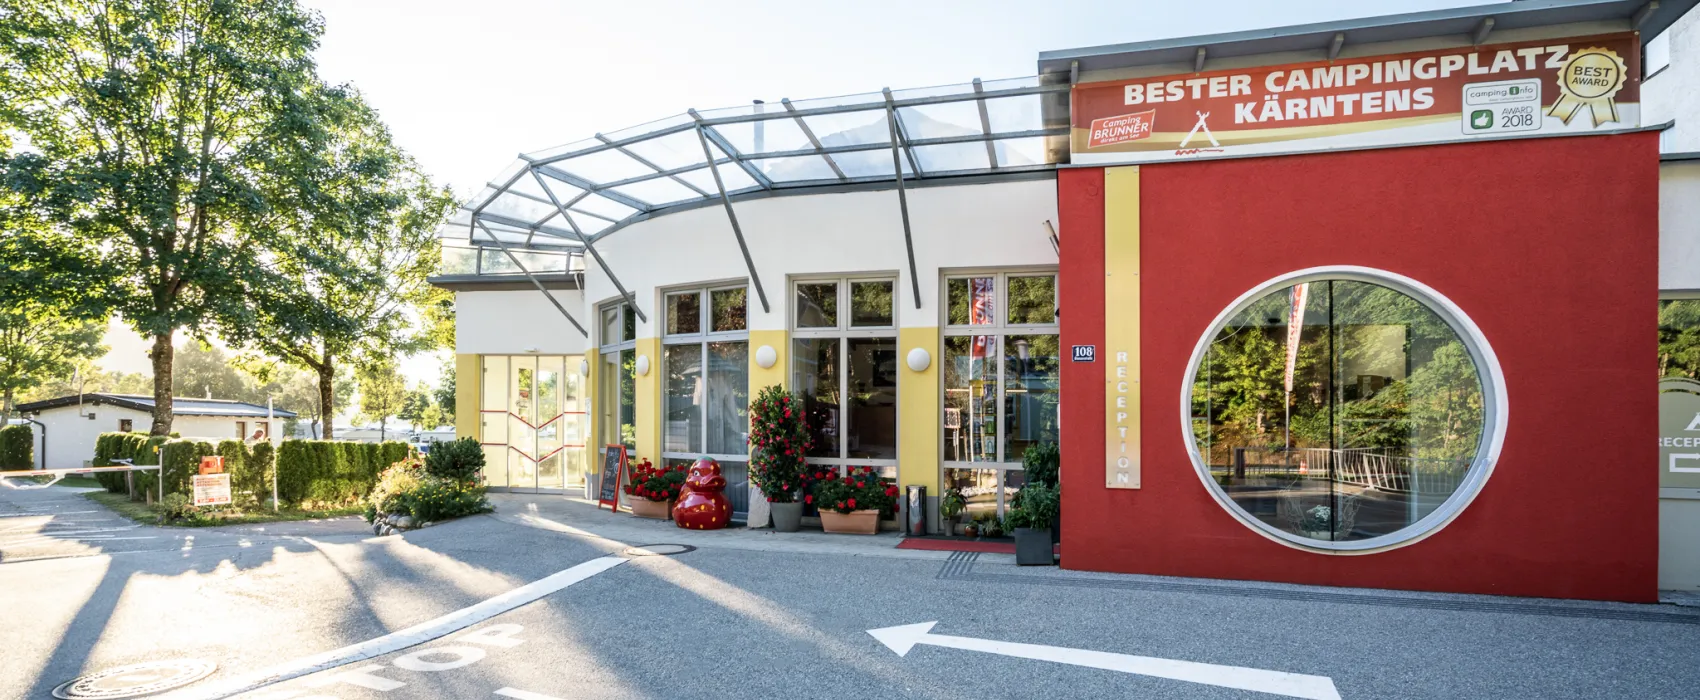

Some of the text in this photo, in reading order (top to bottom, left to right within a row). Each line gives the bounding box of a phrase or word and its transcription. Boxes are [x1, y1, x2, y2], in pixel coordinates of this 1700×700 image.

[1124, 44, 1569, 106] BESTER CAMPINGPLATZ
[1574, 65, 1613, 78] BEST
[1571, 76, 1609, 87] AWARD
[1235, 87, 1435, 125] KÄRNTENS
[1501, 105, 1534, 116] AWARD
[1102, 116, 1142, 128] Camping
[1501, 113, 1534, 128] 2018
[1094, 122, 1149, 140] BRUNNER
[1075, 346, 1094, 357] 108
[1116, 351, 1129, 484] RECEPTION
